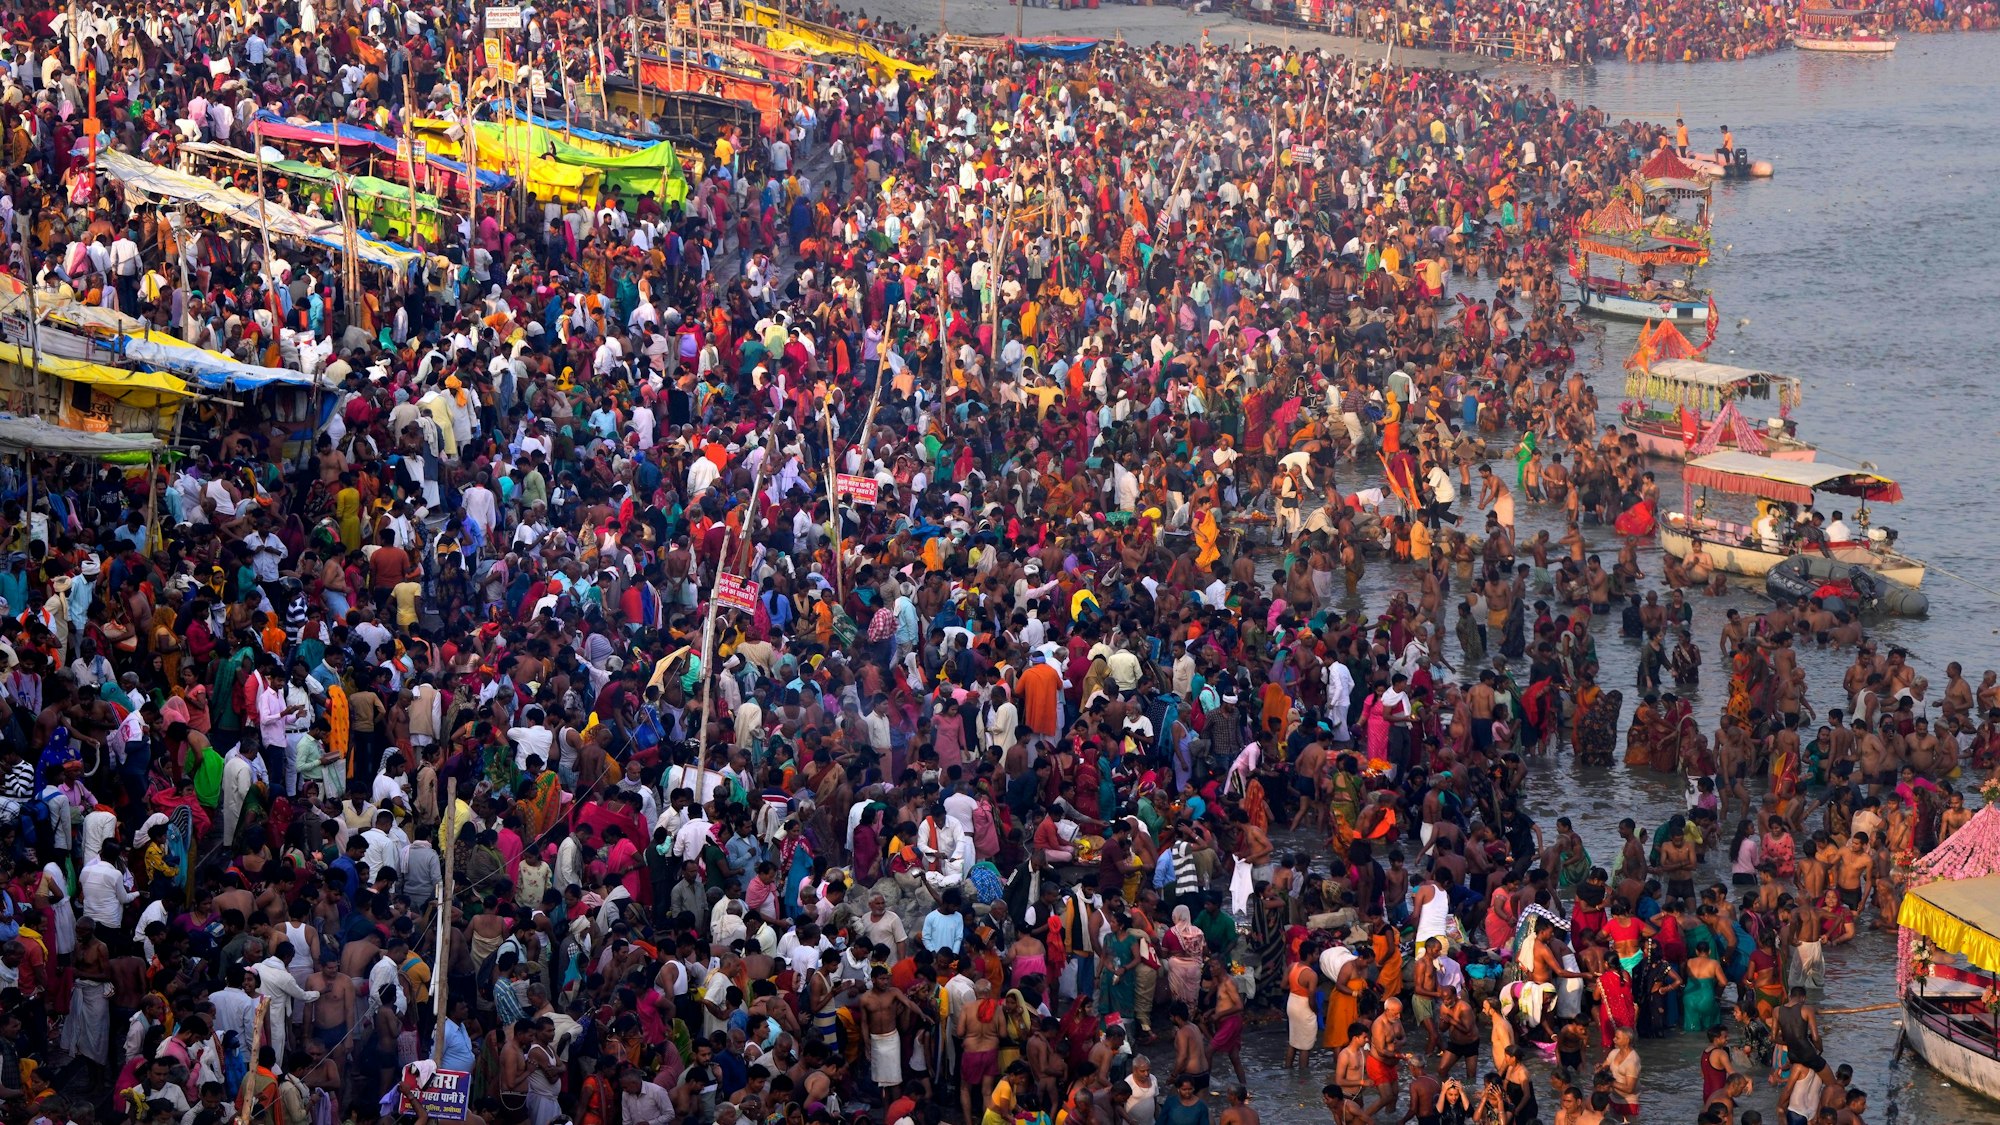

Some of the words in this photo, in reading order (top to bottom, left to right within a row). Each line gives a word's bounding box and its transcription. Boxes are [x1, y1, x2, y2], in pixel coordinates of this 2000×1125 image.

[736, 590, 749, 599] खतरा
[430, 1072, 460, 1090] तरा
[422, 1091, 440, 1101] गहरा
[441, 1090, 458, 1103] पानी
[459, 1092, 465, 1104] है
